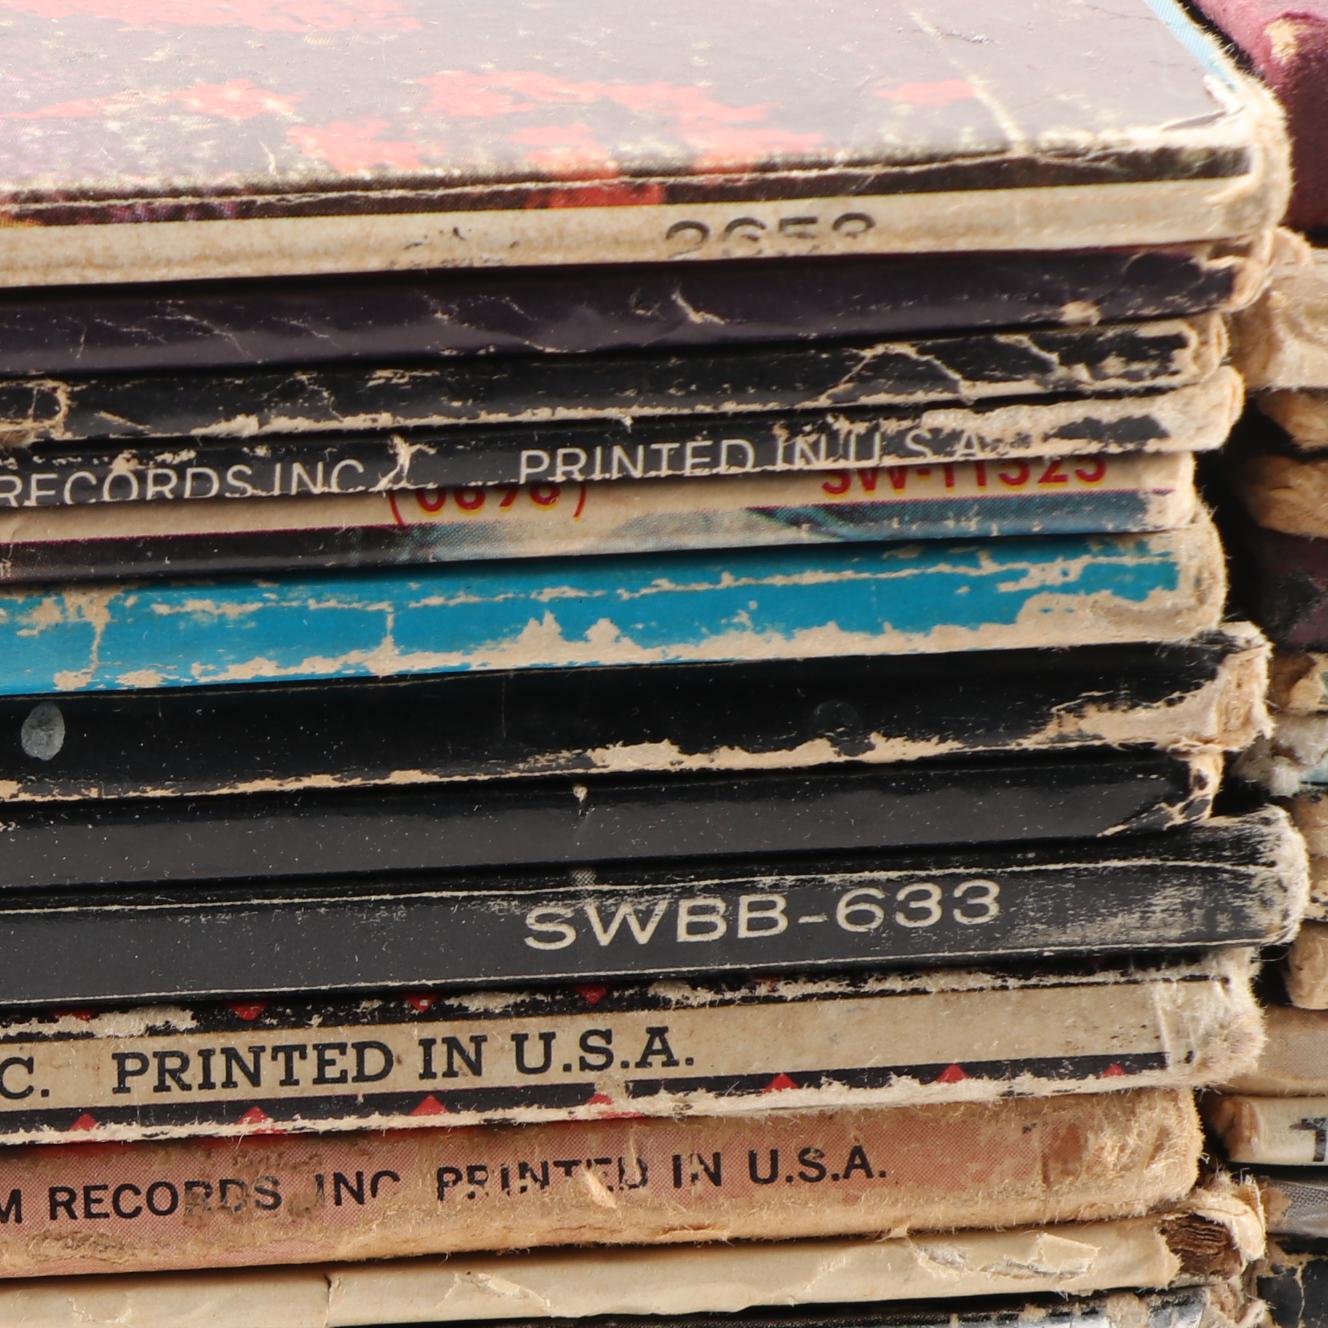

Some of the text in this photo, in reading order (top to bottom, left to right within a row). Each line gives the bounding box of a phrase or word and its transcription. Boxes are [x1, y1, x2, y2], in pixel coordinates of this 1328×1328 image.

[519, 439, 756, 484] PRINTED
[523, 880, 1002, 951] SWBB-633
[111, 1040, 394, 1095] PRINTED
[417, 1033, 491, 1080] IN
[510, 1026, 696, 1075] U.S.A.
[672, 1151, 723, 1189] IN
[747, 1144, 887, 1186] U.S.A.
